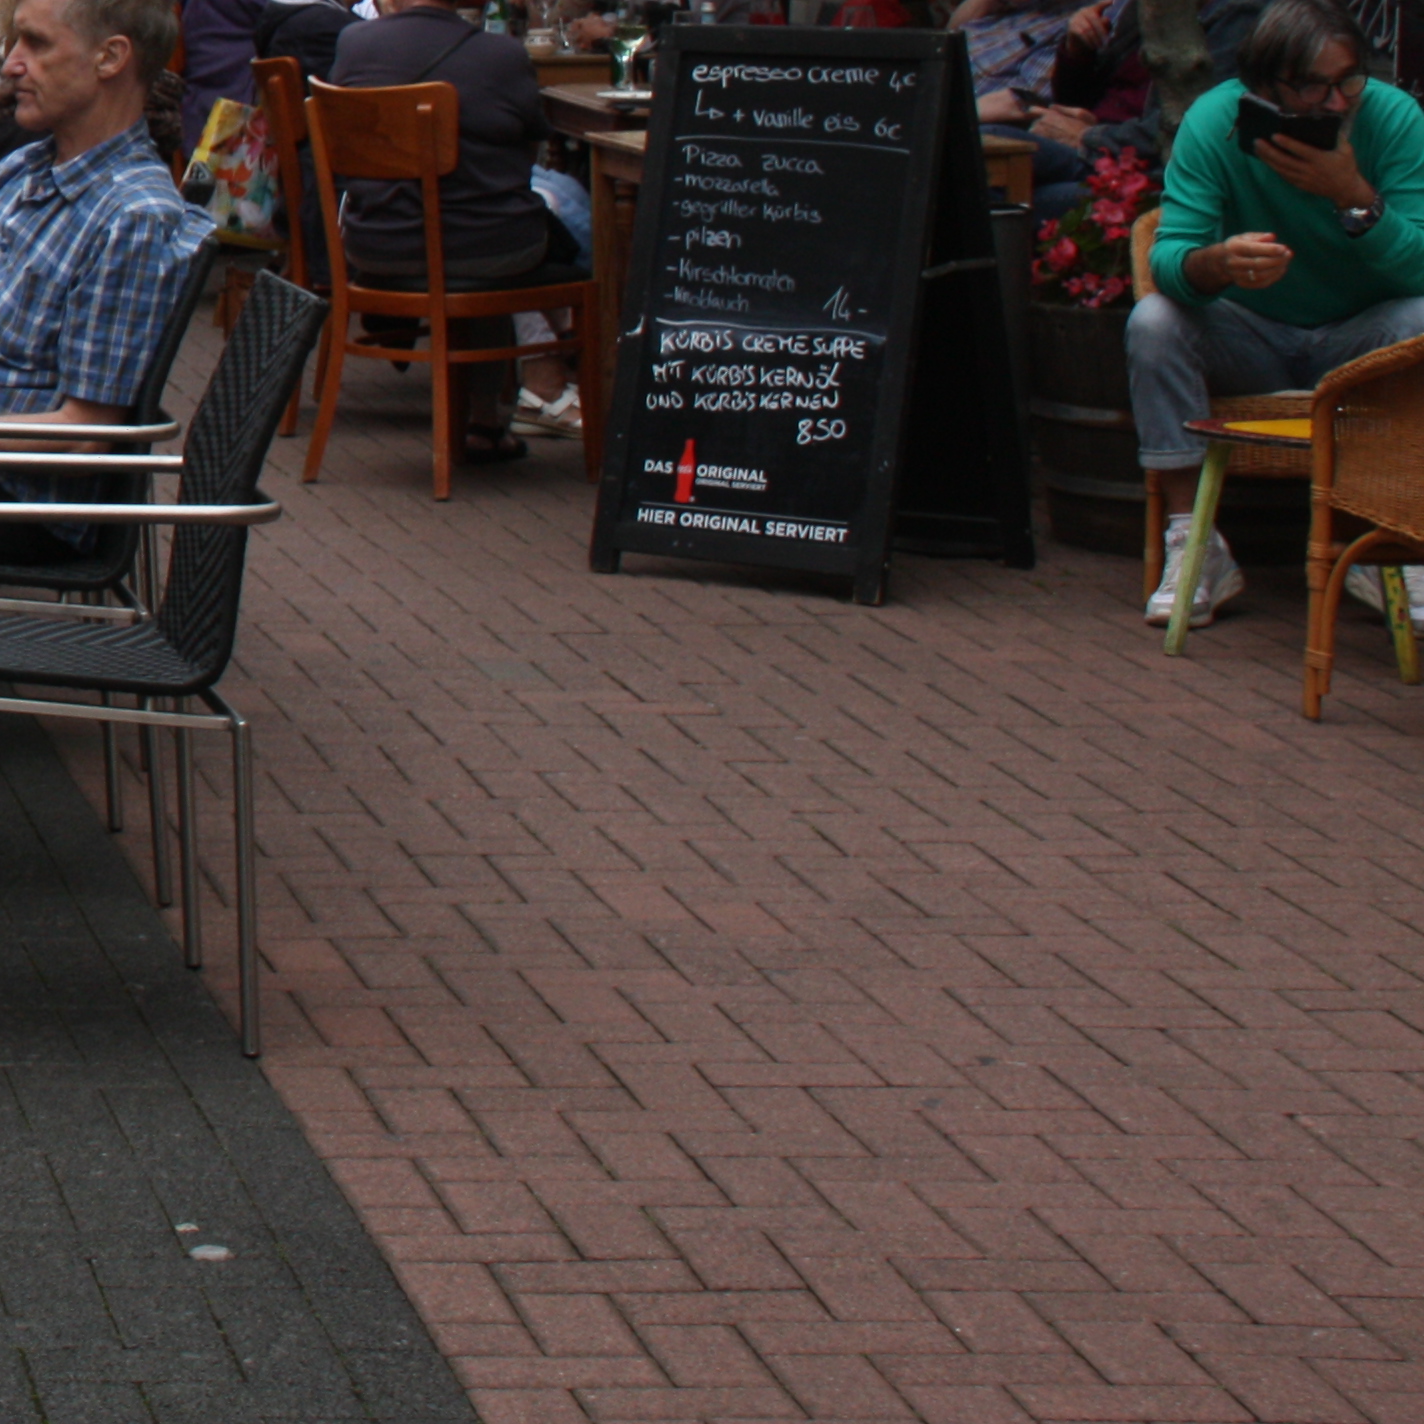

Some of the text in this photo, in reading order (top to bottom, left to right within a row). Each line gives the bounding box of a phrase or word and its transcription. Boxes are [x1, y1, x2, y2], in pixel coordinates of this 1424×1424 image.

[681, 144, 743, 168] Pizza
[644, 458, 674, 475] DAS
[696, 463, 768, 483] ORIGINAL
[637, 507, 849, 543] HIER ORIGINAL SERVIERT
